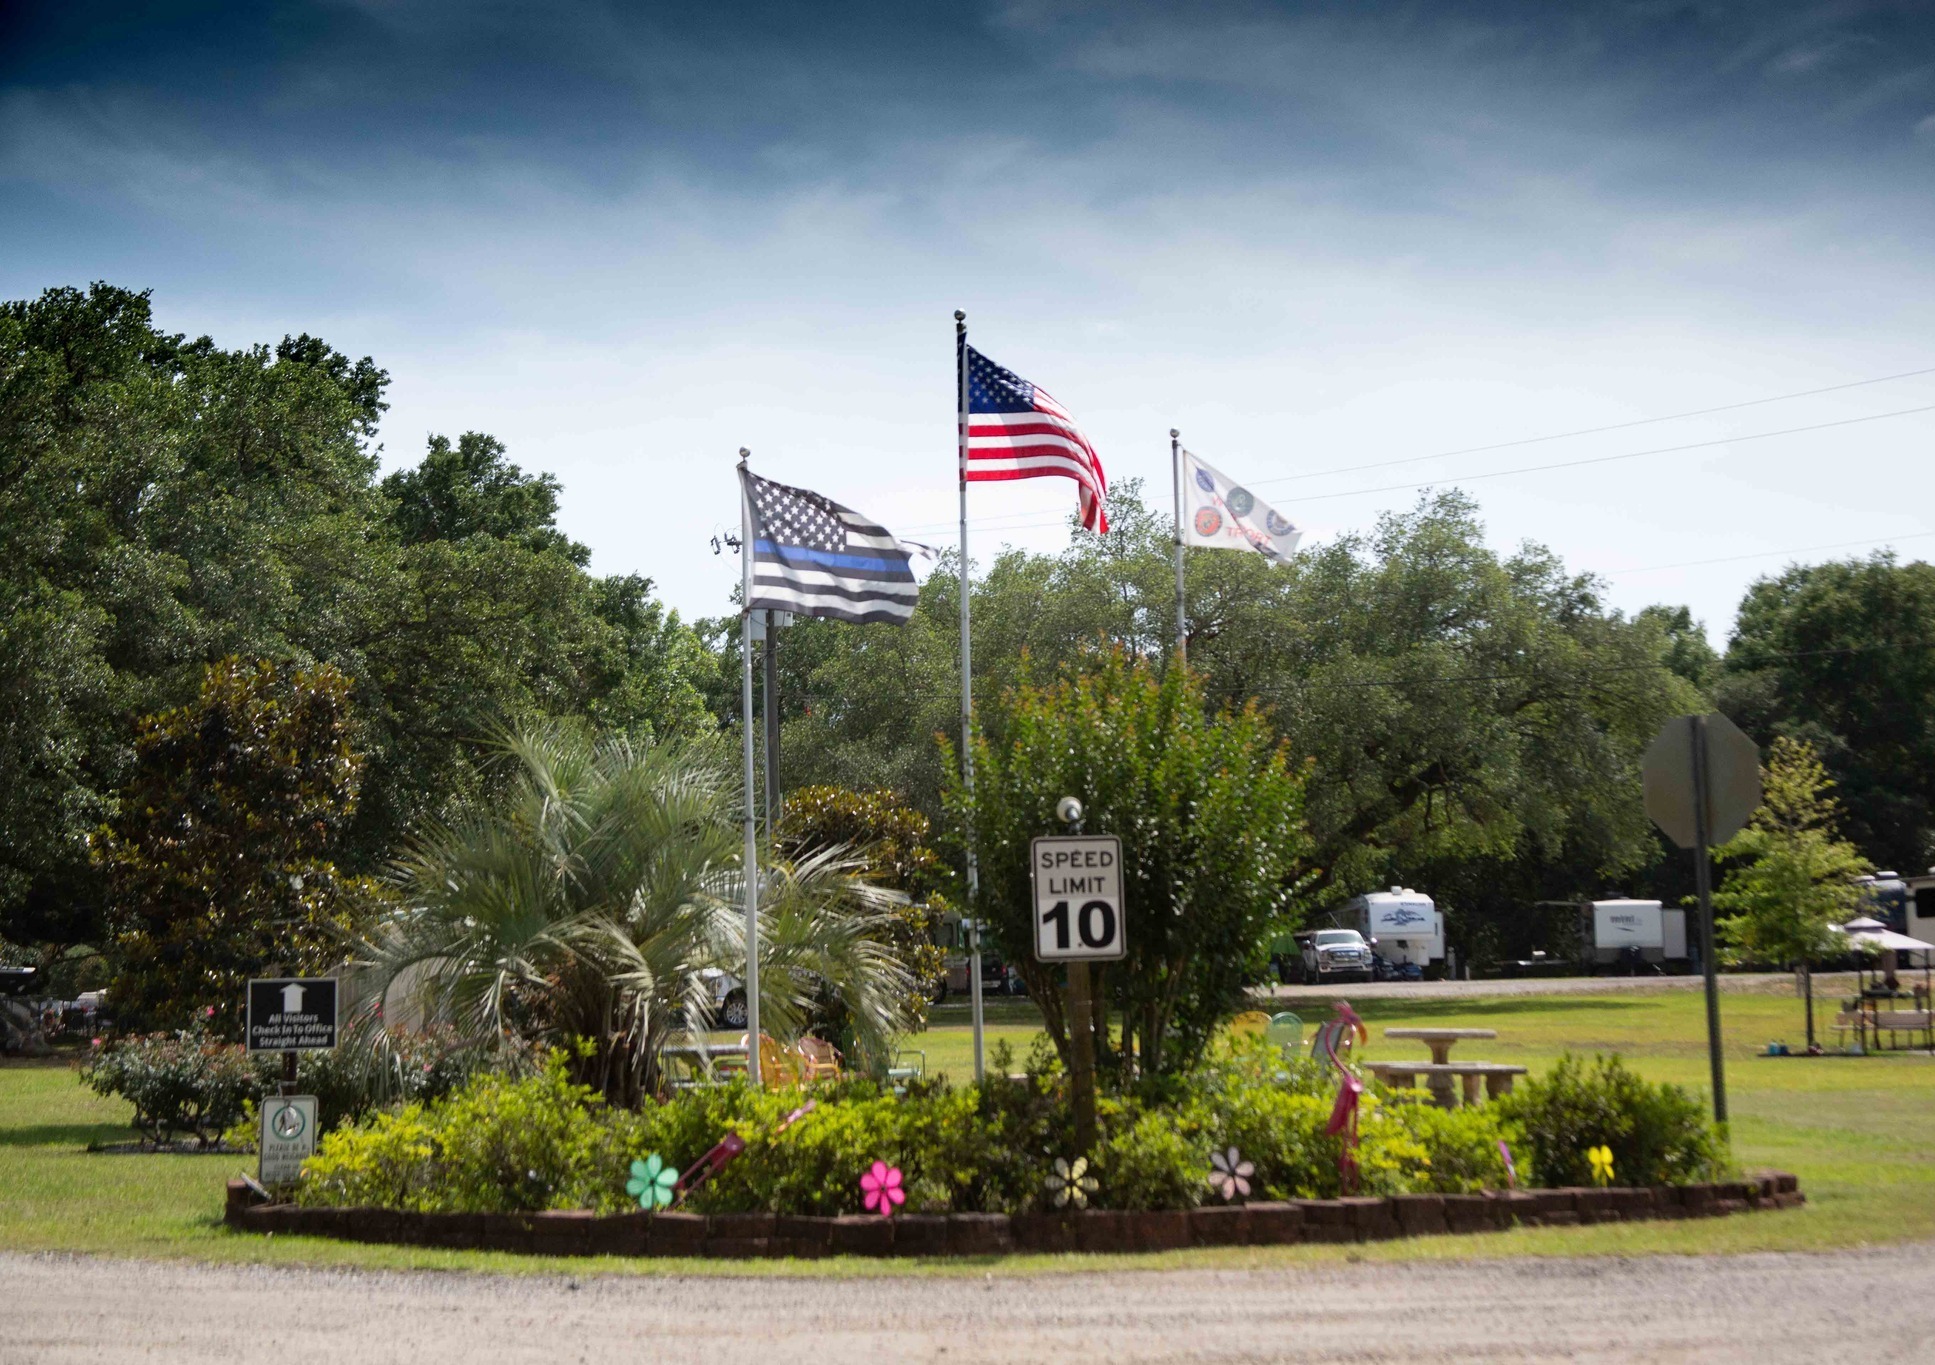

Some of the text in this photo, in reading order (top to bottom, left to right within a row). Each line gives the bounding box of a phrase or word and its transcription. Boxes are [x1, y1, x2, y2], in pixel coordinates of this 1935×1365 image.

[1041, 850, 1113, 869] SPEED
[1049, 877, 1105, 894] LIMIT
[1042, 900, 1116, 949] 10
[268, 1013, 319, 1024] All Visitors
[252, 1025, 281, 1036] Check
[293, 1024, 304, 1035] To
[304, 1023, 333, 1034] Office
[259, 1034, 328, 1048] Straight Ahead
